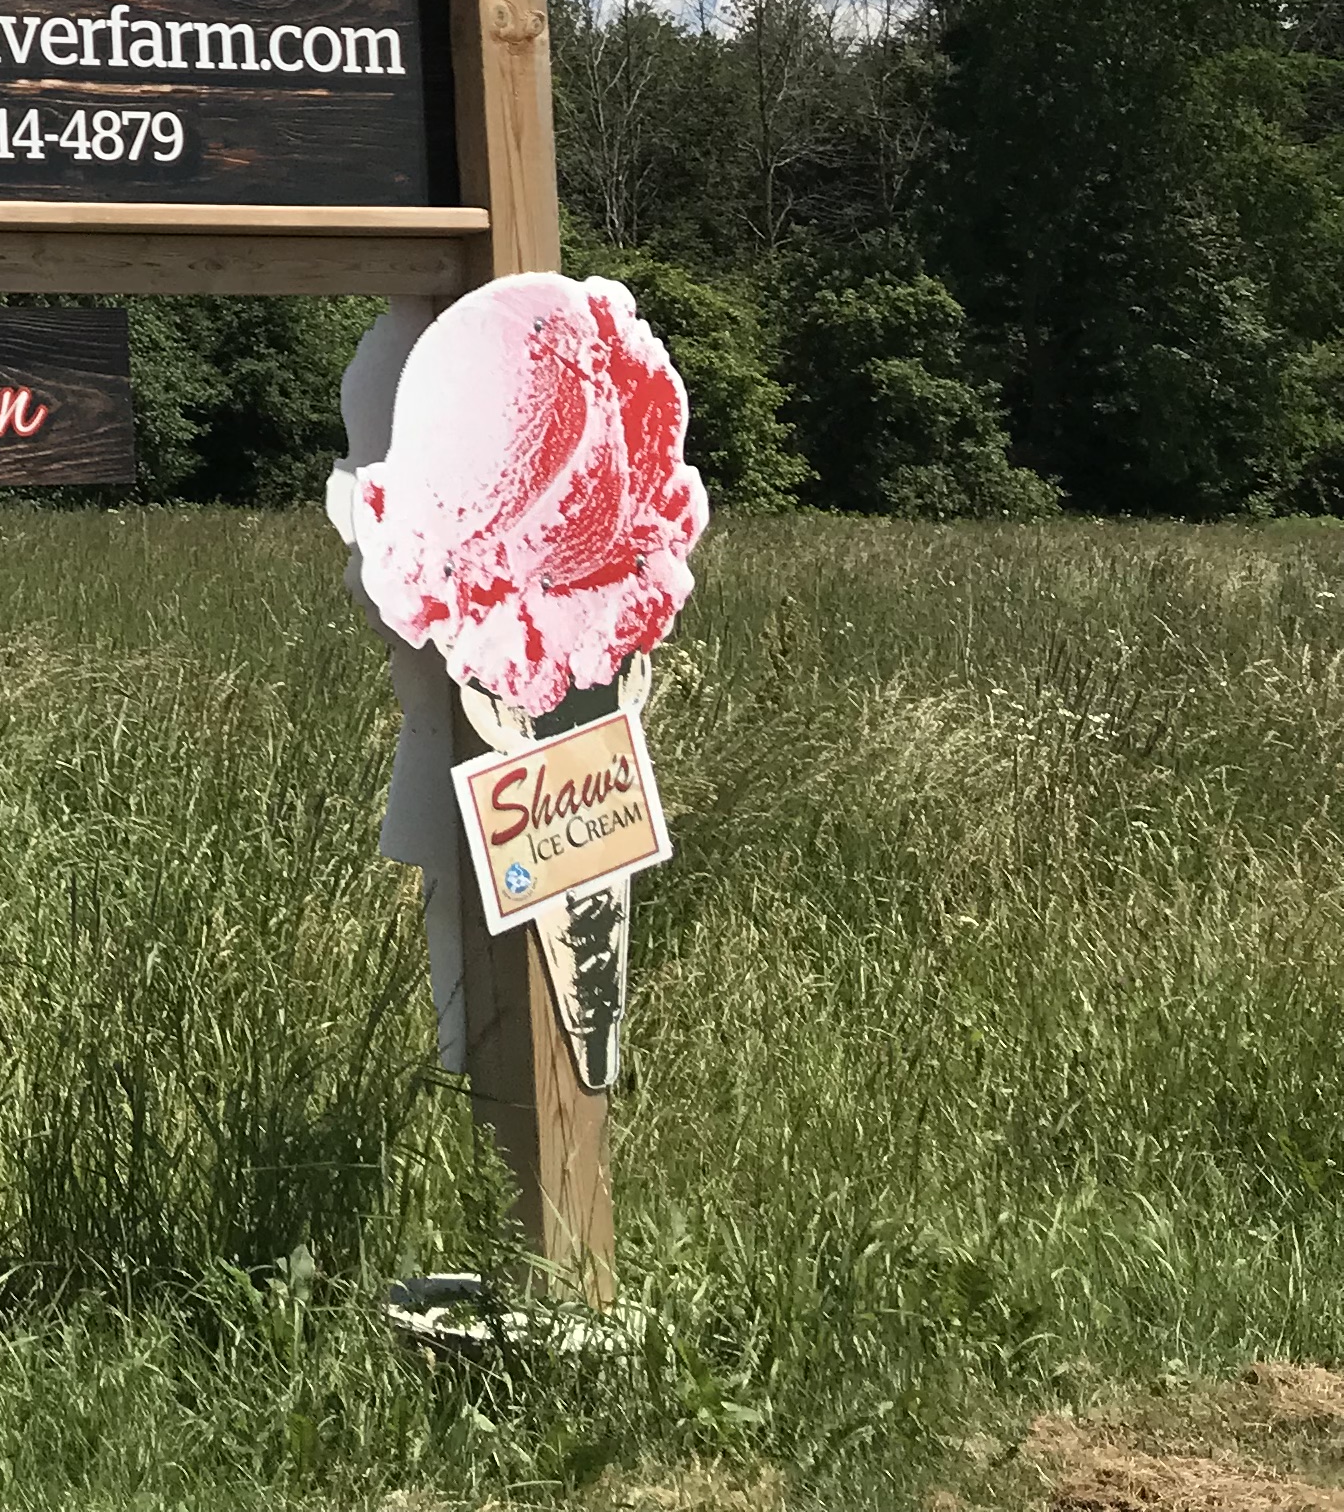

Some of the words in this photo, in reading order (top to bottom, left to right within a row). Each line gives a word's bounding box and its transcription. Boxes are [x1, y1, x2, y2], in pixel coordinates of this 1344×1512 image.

[490, 754, 634, 846] Shaw's
[527, 834, 564, 864] ICE
[565, 803, 643, 848] CREAM
